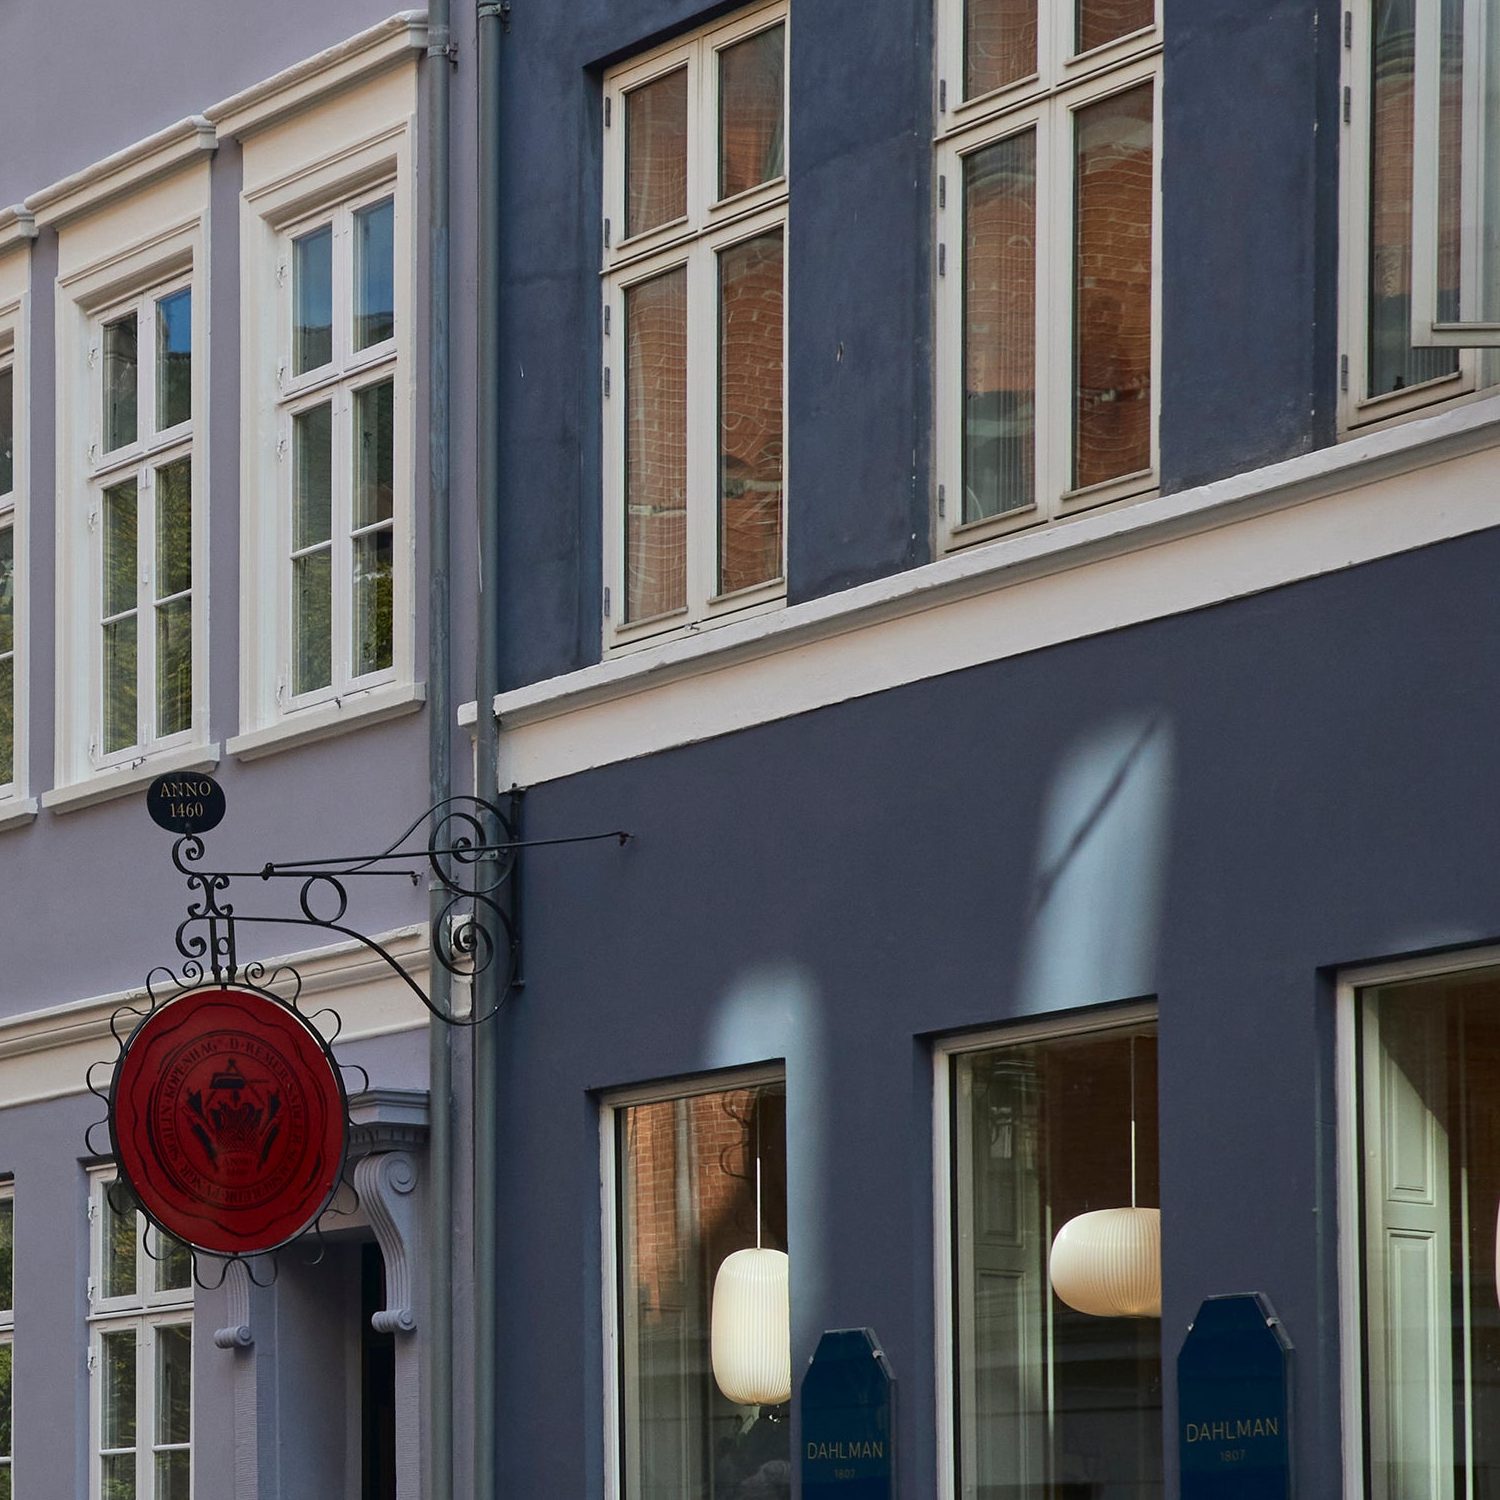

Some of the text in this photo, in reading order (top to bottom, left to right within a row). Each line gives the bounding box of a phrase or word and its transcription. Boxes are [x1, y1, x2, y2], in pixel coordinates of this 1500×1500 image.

[160, 780, 211, 798] ANNO
[170, 802, 204, 818] 1460
[1186, 1416, 1279, 1443] DAHLMAN
[806, 1440, 884, 1460] DAHLMAN
